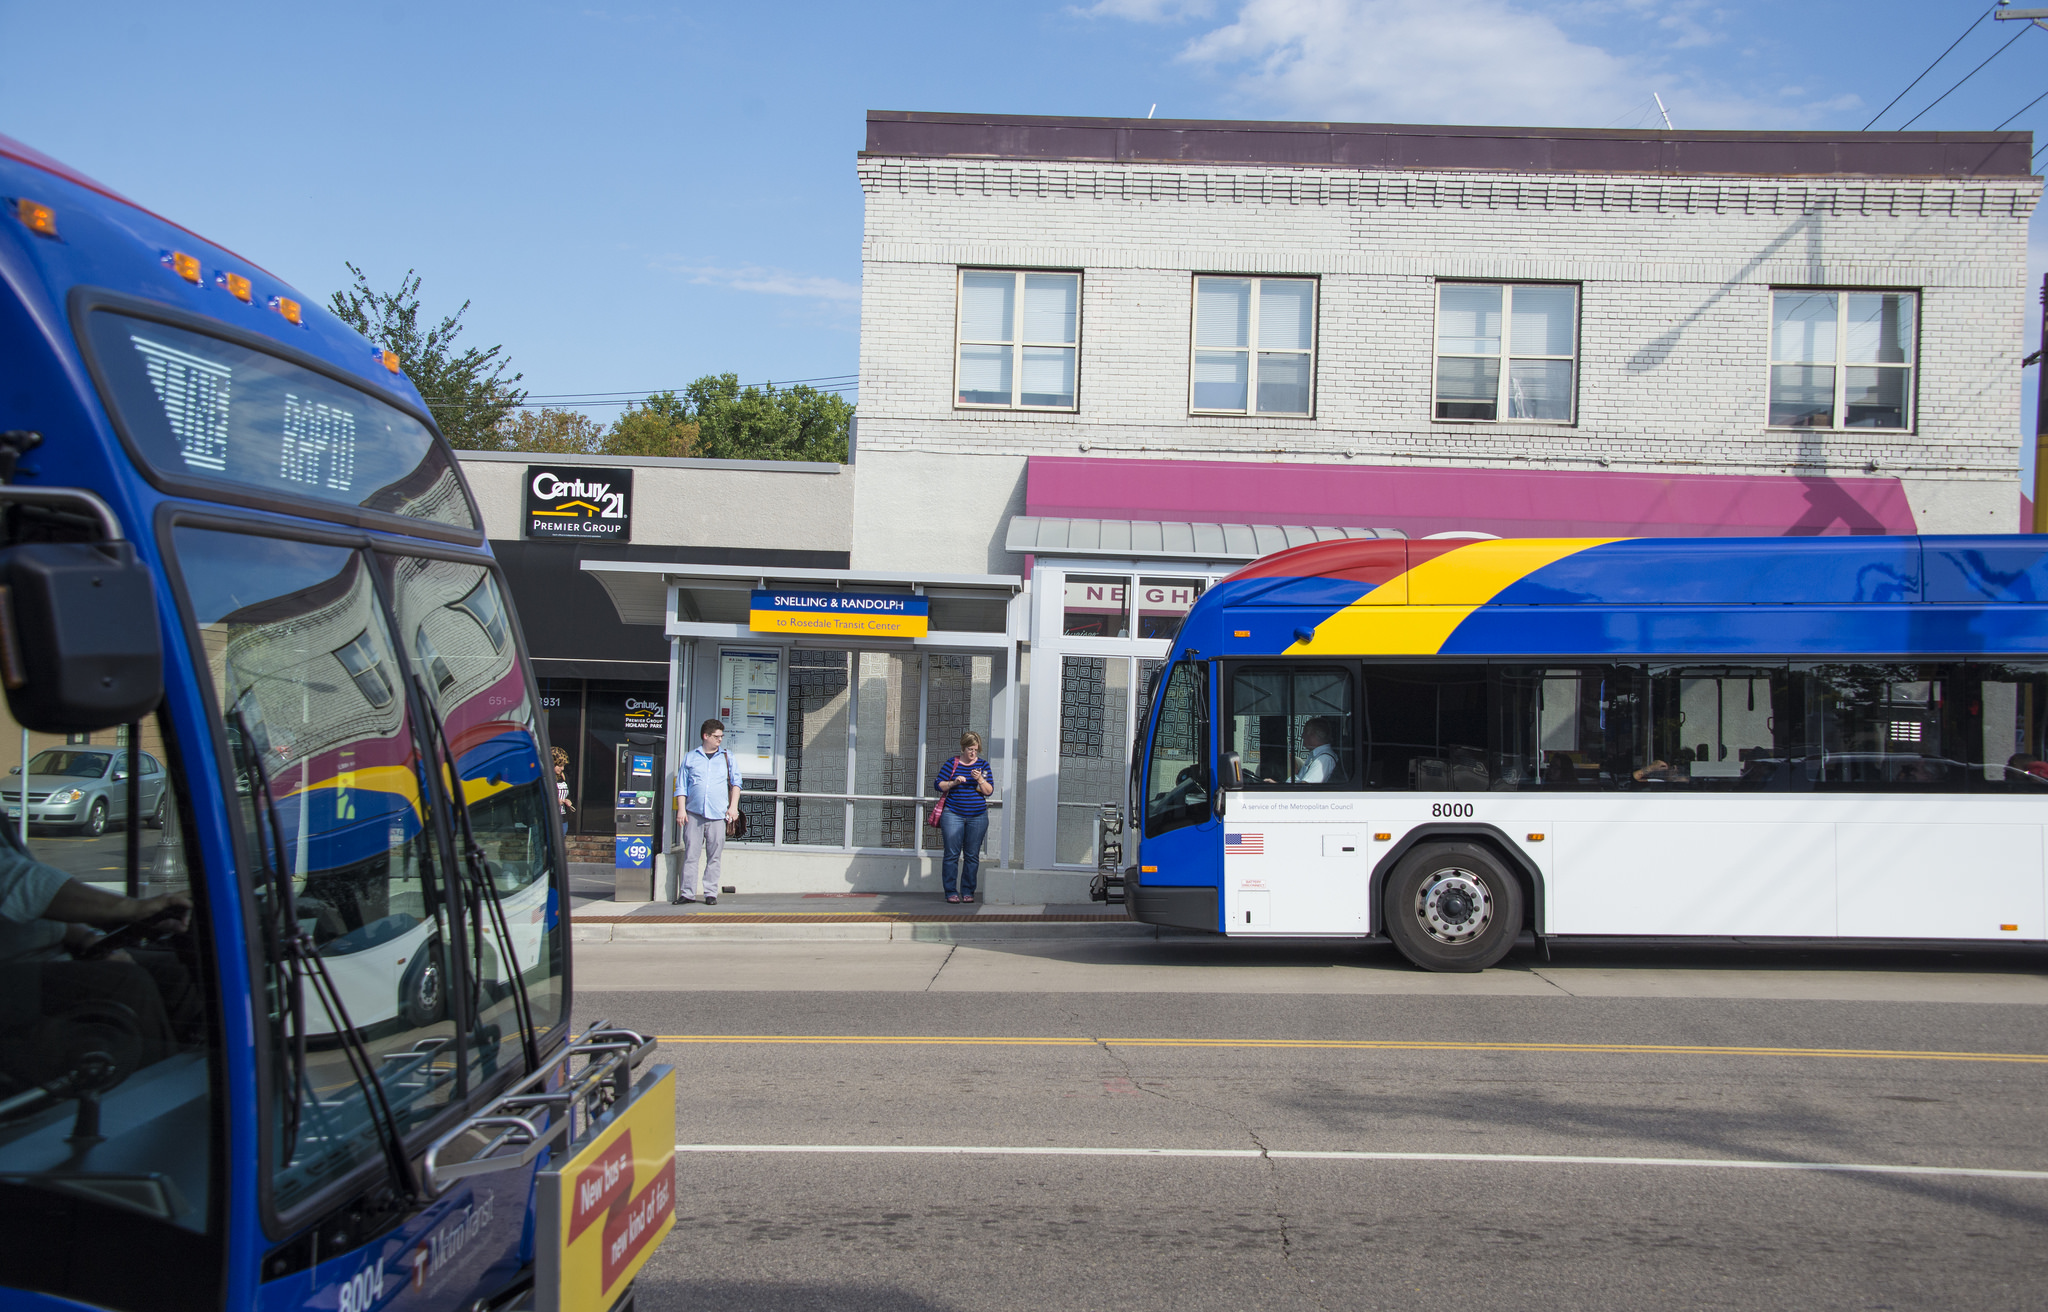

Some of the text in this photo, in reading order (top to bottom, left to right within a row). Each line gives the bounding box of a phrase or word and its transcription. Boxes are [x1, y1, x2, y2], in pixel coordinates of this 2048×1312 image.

[533, 472, 624, 519] Century 21
[533, 520, 622, 533] PREMIER GROUP
[774, 596, 904, 611] SNELLING & RANDOLPH
[776, 617, 901, 631] to Rosedale Transit Center
[625, 698, 664, 717] Century 21
[1290, 803, 1329, 811] Metropolitan
[1432, 803, 1474, 817] 8000
[630, 845, 647, 857] go
[580, 1174, 603, 1216] New
[604, 1159, 619, 1193] bus
[611, 1227, 628, 1267] new
[629, 1199, 645, 1245] kind
[646, 1189, 655, 1224] of
[338, 1256, 385, 1312] 8004
